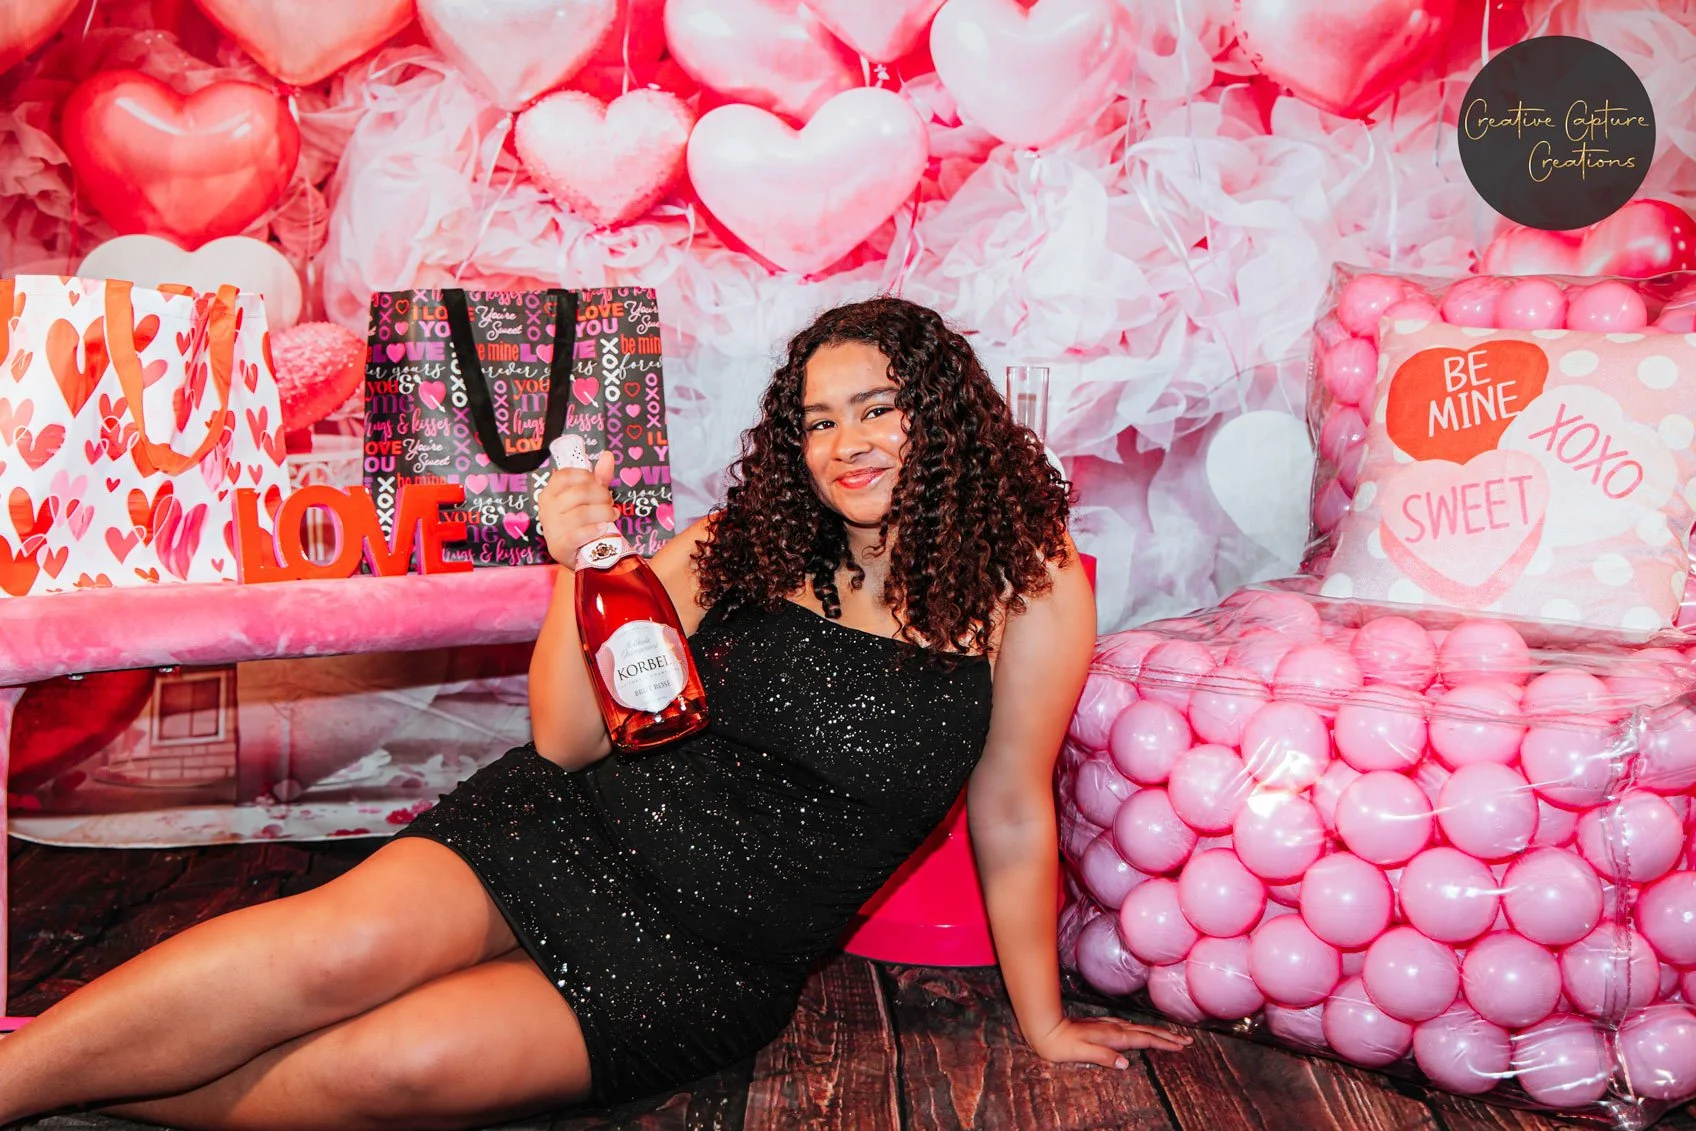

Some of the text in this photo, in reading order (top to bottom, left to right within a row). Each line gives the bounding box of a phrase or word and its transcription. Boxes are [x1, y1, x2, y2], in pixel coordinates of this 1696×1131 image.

[475, 305, 517, 328] You're
[576, 302, 624, 322] LOVE
[419, 320, 452, 338] YO
[486, 320, 522, 341] Sweet
[576, 317, 619, 339] YOU
[487, 340, 519, 361] mine
[621, 333, 662, 355] be min
[481, 361, 538, 379] orever
[1443, 350, 1491, 392] BE
[364, 374, 415, 402] you &
[372, 394, 415, 414] me
[522, 392, 549, 412] m
[1428, 380, 1521, 438] MINE
[364, 408, 451, 444] hugs & kisses
[513, 403, 605, 441] hugs kisses
[364, 440, 403, 455] OVE
[402, 438, 444, 460] You're
[504, 437, 544, 453] LOV
[1528, 403, 1644, 500] XOXO
[364, 455, 397, 473] OU
[413, 452, 451, 473] Sweet
[481, 505, 499, 526] &
[1401, 474, 1534, 544] SWEET
[231, 484, 474, 584] LOVE
[480, 543, 493, 563] &
[495, 539, 534, 566] kisses
[617, 655, 672, 681] KORBEL
